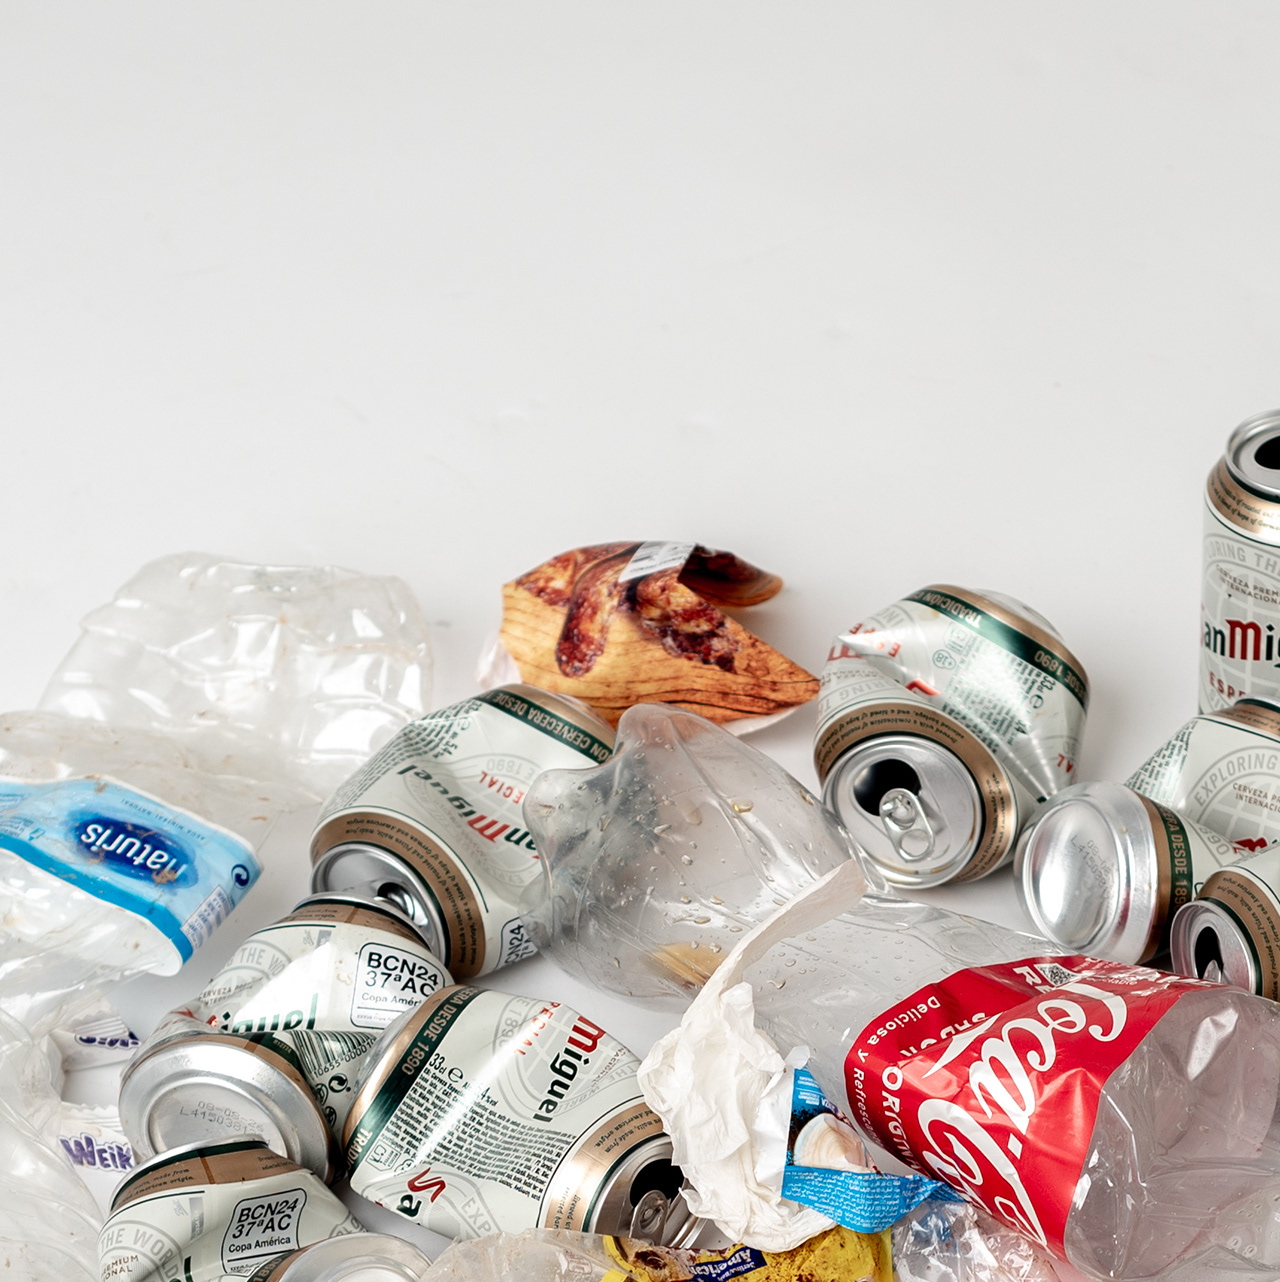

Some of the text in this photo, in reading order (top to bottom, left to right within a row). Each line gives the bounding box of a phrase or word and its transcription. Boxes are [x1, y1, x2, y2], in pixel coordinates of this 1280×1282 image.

[1215, 562, 1253, 590] CERVEZA
[1033, 648, 1064, 678] 1890
[525, 707, 599, 751] CERVECERA
[1192, 751, 1280, 807] EXPLORING
[1231, 780, 1270, 801] CERVEZA
[80, 821, 187, 880] naturis
[1167, 832, 1189, 878] DESDE
[365, 950, 440, 988] BCN24
[360, 991, 389, 1006] Copa
[400, 976, 437, 998] AC
[867, 994, 942, 1046] Deliciosa
[401, 1008, 456, 1077] DESDE 1890
[236, 1197, 301, 1225] BCN24
[265, 1212, 293, 1233] AC
[228, 1234, 292, 1254] Copa América
